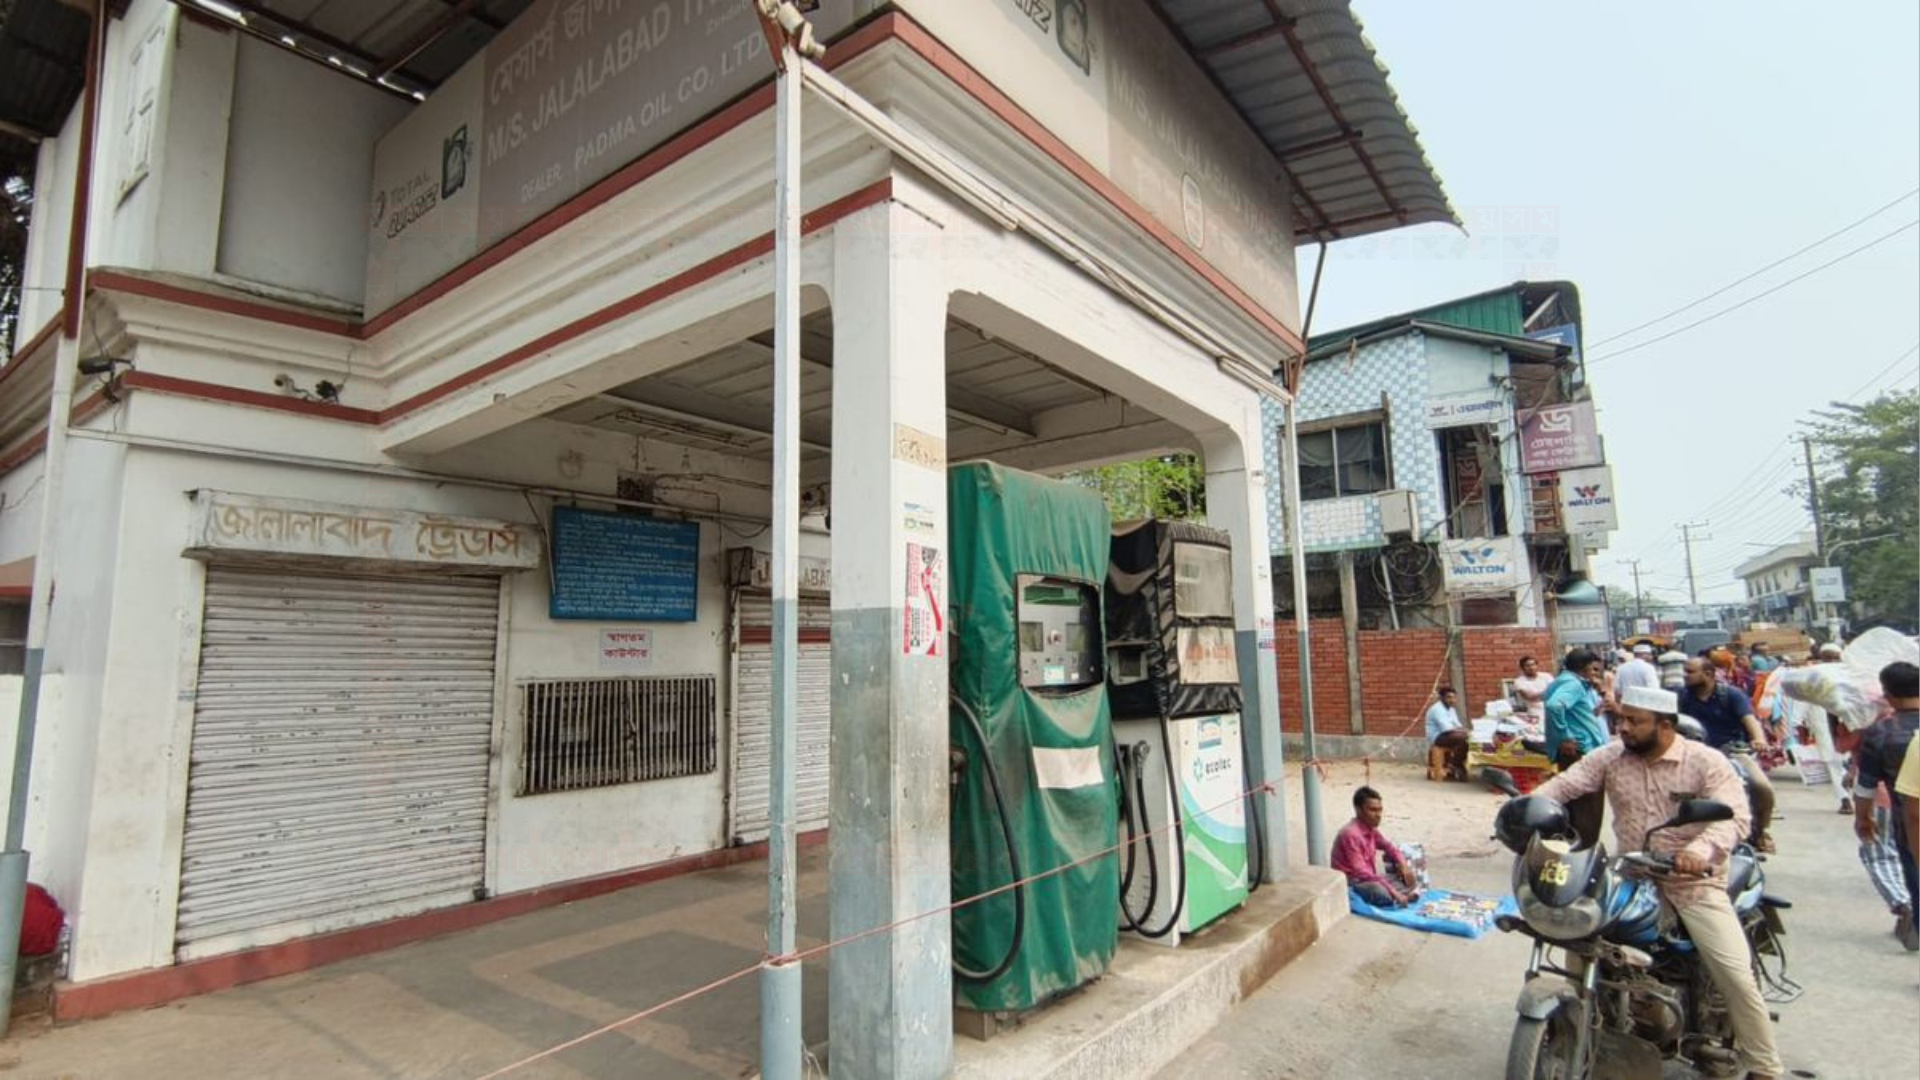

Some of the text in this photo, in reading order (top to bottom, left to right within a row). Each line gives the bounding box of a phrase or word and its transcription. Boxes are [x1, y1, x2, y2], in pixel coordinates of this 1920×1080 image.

[532, 2, 671, 131] JALALABAD
[575, 115, 637, 171] PADMA
[640, 92, 672, 126] OIL
[1453, 565, 1506, 576] WALTON
